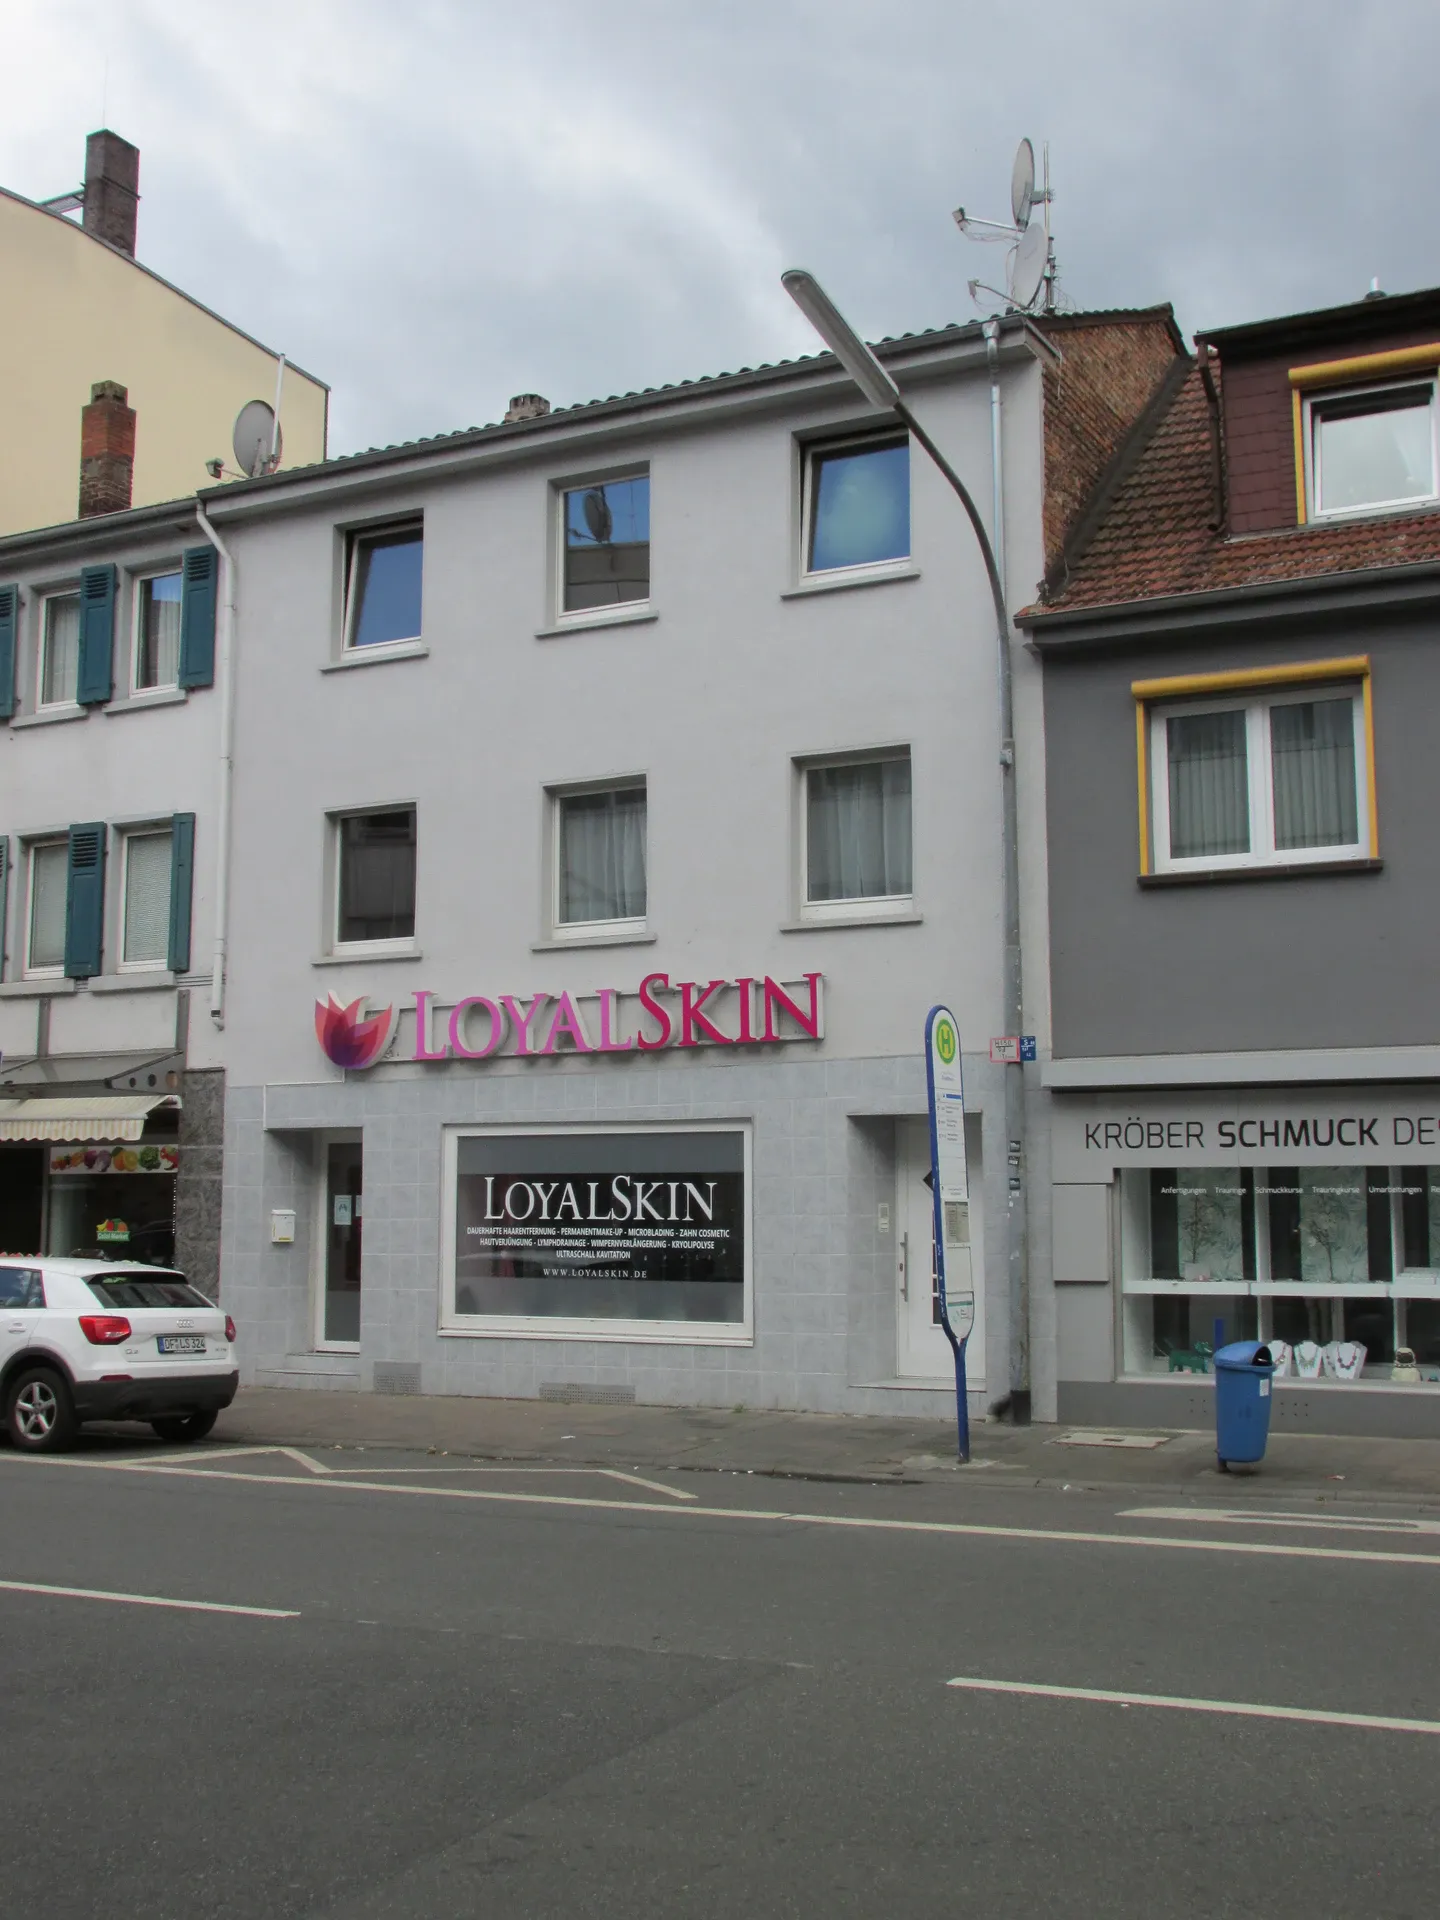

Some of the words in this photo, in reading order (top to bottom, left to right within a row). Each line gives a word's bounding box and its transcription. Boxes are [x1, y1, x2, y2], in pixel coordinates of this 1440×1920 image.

[411, 973, 823, 1061] LOYALSKIN
[1085, 1117, 1205, 1149] KRÖBER
[1217, 1117, 1379, 1148] SCHMUCK
[1392, 1117, 1440, 1146] DE
[1160, 1186, 1207, 1196] Anfertigungen
[1214, 1186, 1247, 1196] Trauringe
[1254, 1186, 1304, 1195] Schmuckkurse
[1311, 1186, 1360, 1196] Trauringkurse
[1368, 1186, 1423, 1195] Umarbeitungen
[483, 1175, 718, 1221] LOYALSKIN
[466, 1226, 502, 1235] DAUERHAFTE
[503, 1227, 556, 1236] HAARENTFERNUNG
[628, 1228, 675, 1237] MICROBLADING
[679, 1229, 698, 1237] ZAHN
[698, 1229, 730, 1238] COSMETIC
[480, 1236, 533, 1246] HAUTVERJÜNGUNG
[537, 1238, 586, 1247] LYMPHDRAINAGE
[591, 1238, 667, 1249] WIMPERNVERLÄNGERUNG
[671, 1240, 715, 1249] KRYOLIPOLYSE
[556, 1250, 595, 1259] ULTRASCHALL
[596, 1250, 631, 1259] KAVITATION
[179, 1338, 191, 1349] LS
